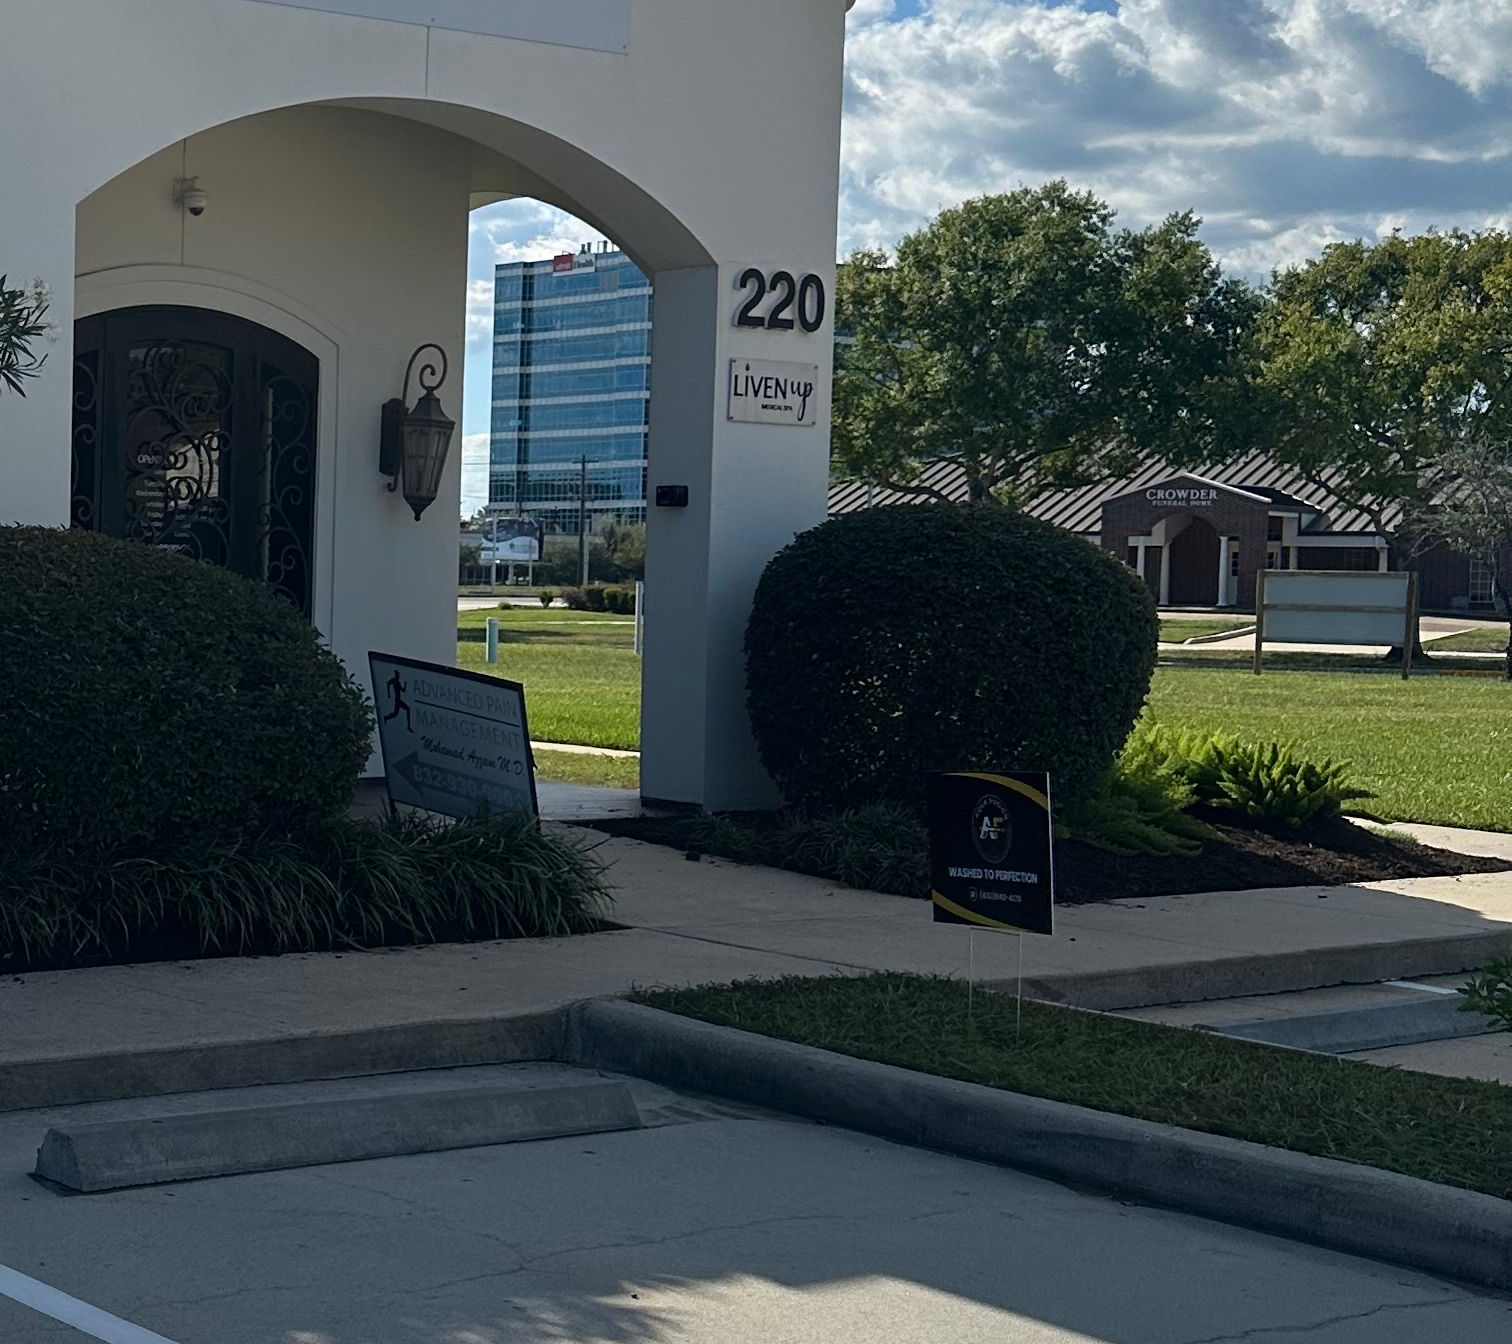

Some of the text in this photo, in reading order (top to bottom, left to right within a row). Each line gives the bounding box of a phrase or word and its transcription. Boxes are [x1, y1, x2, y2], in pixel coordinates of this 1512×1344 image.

[735, 267, 826, 333] 220
[1145, 488, 1218, 500] CROWDER
[412, 679, 518, 719] ADVANCED PAIN
[414, 709, 520, 749] MANAGEMENT
[948, 866, 1038, 884] WASHED TO PERFECTION
